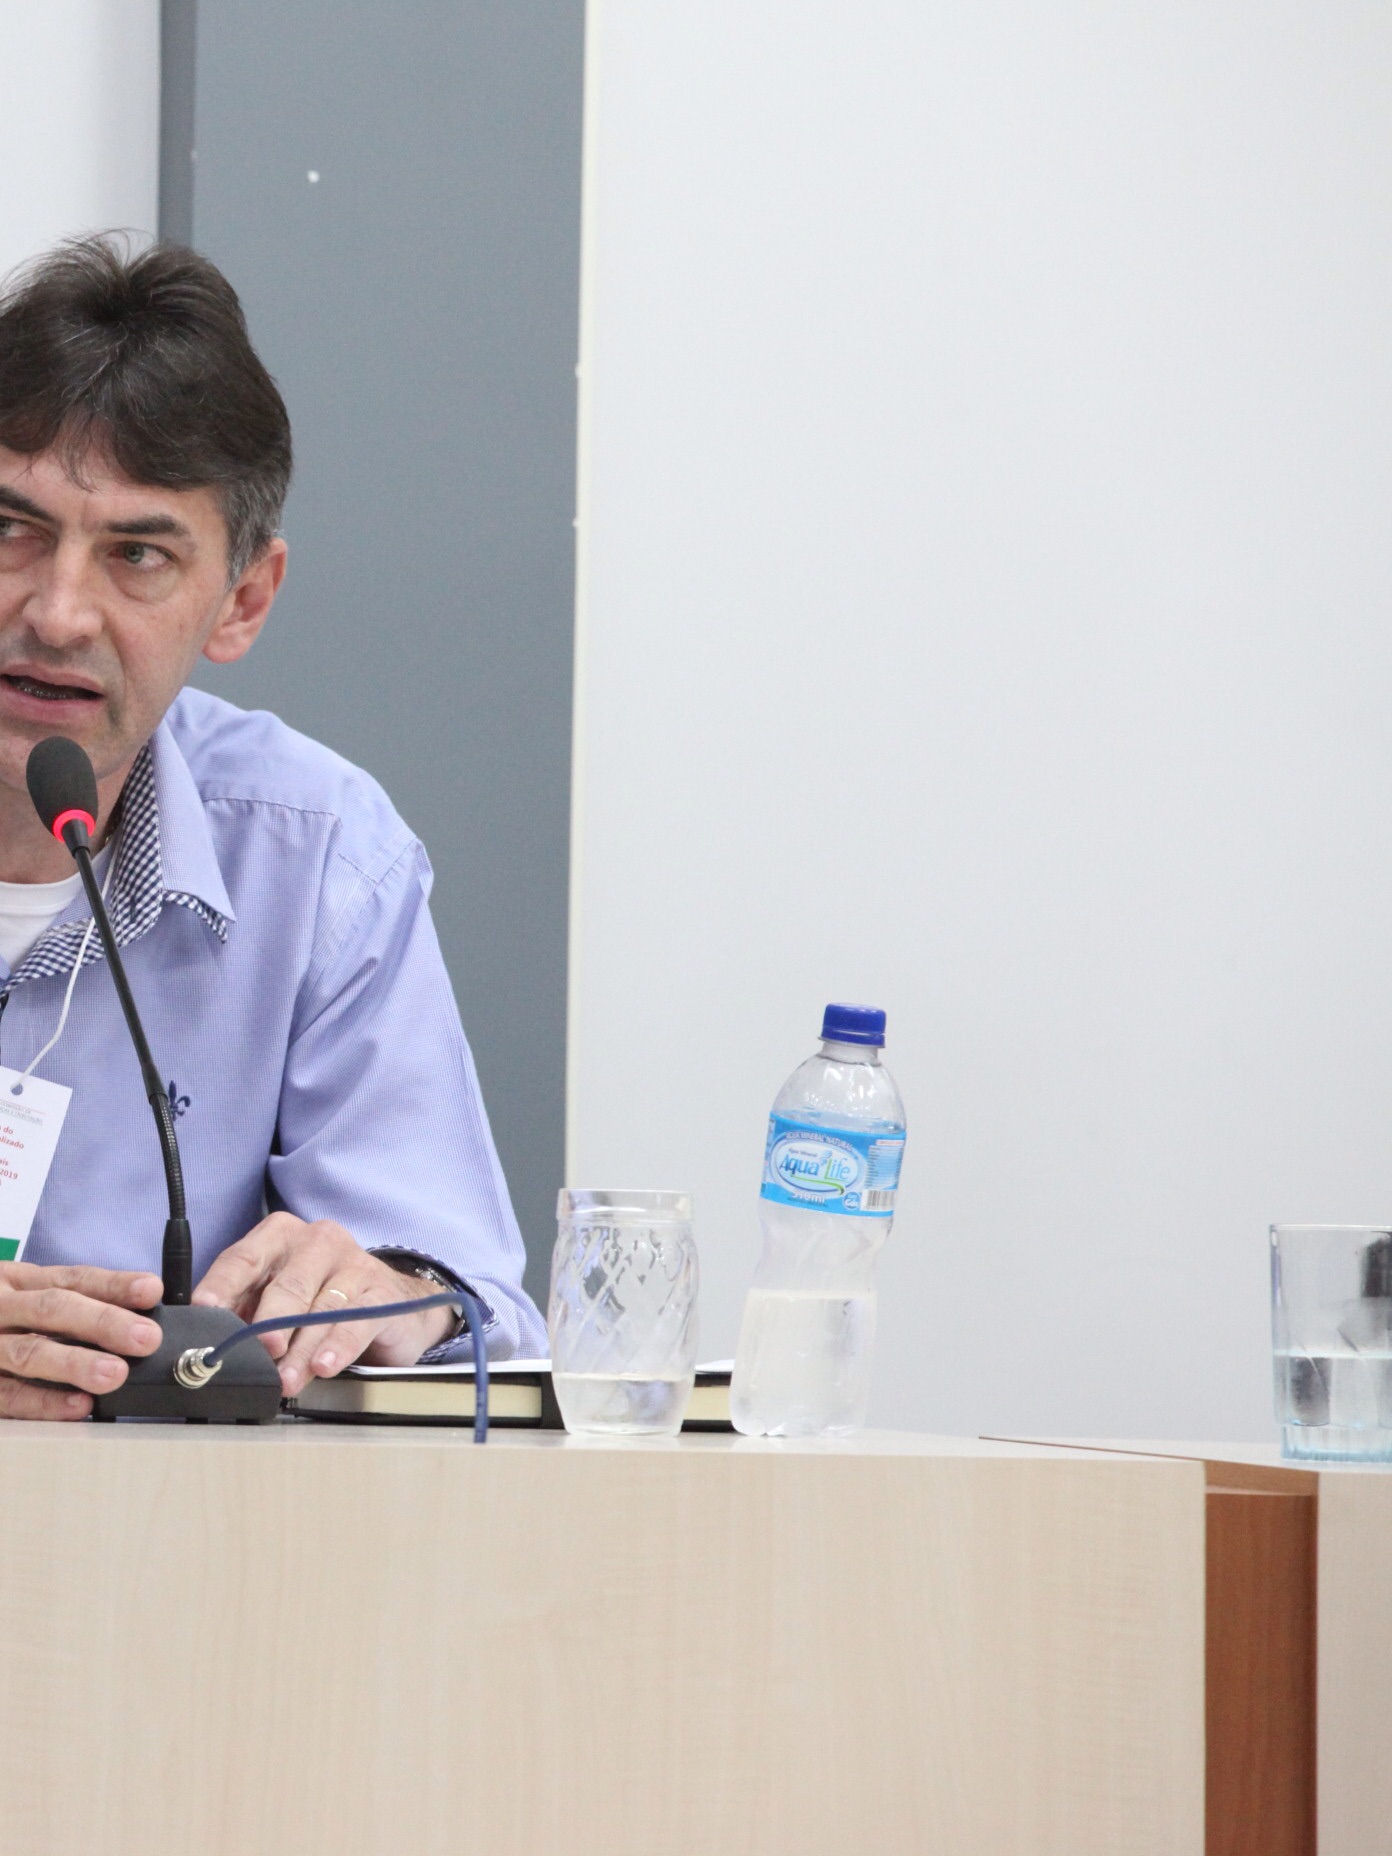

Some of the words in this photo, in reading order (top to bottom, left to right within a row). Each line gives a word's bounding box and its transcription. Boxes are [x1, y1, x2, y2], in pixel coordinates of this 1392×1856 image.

[3, 1124, 14, 1135] do
[779, 1153, 820, 1176] Aqua
[824, 1157, 850, 1180] Life
